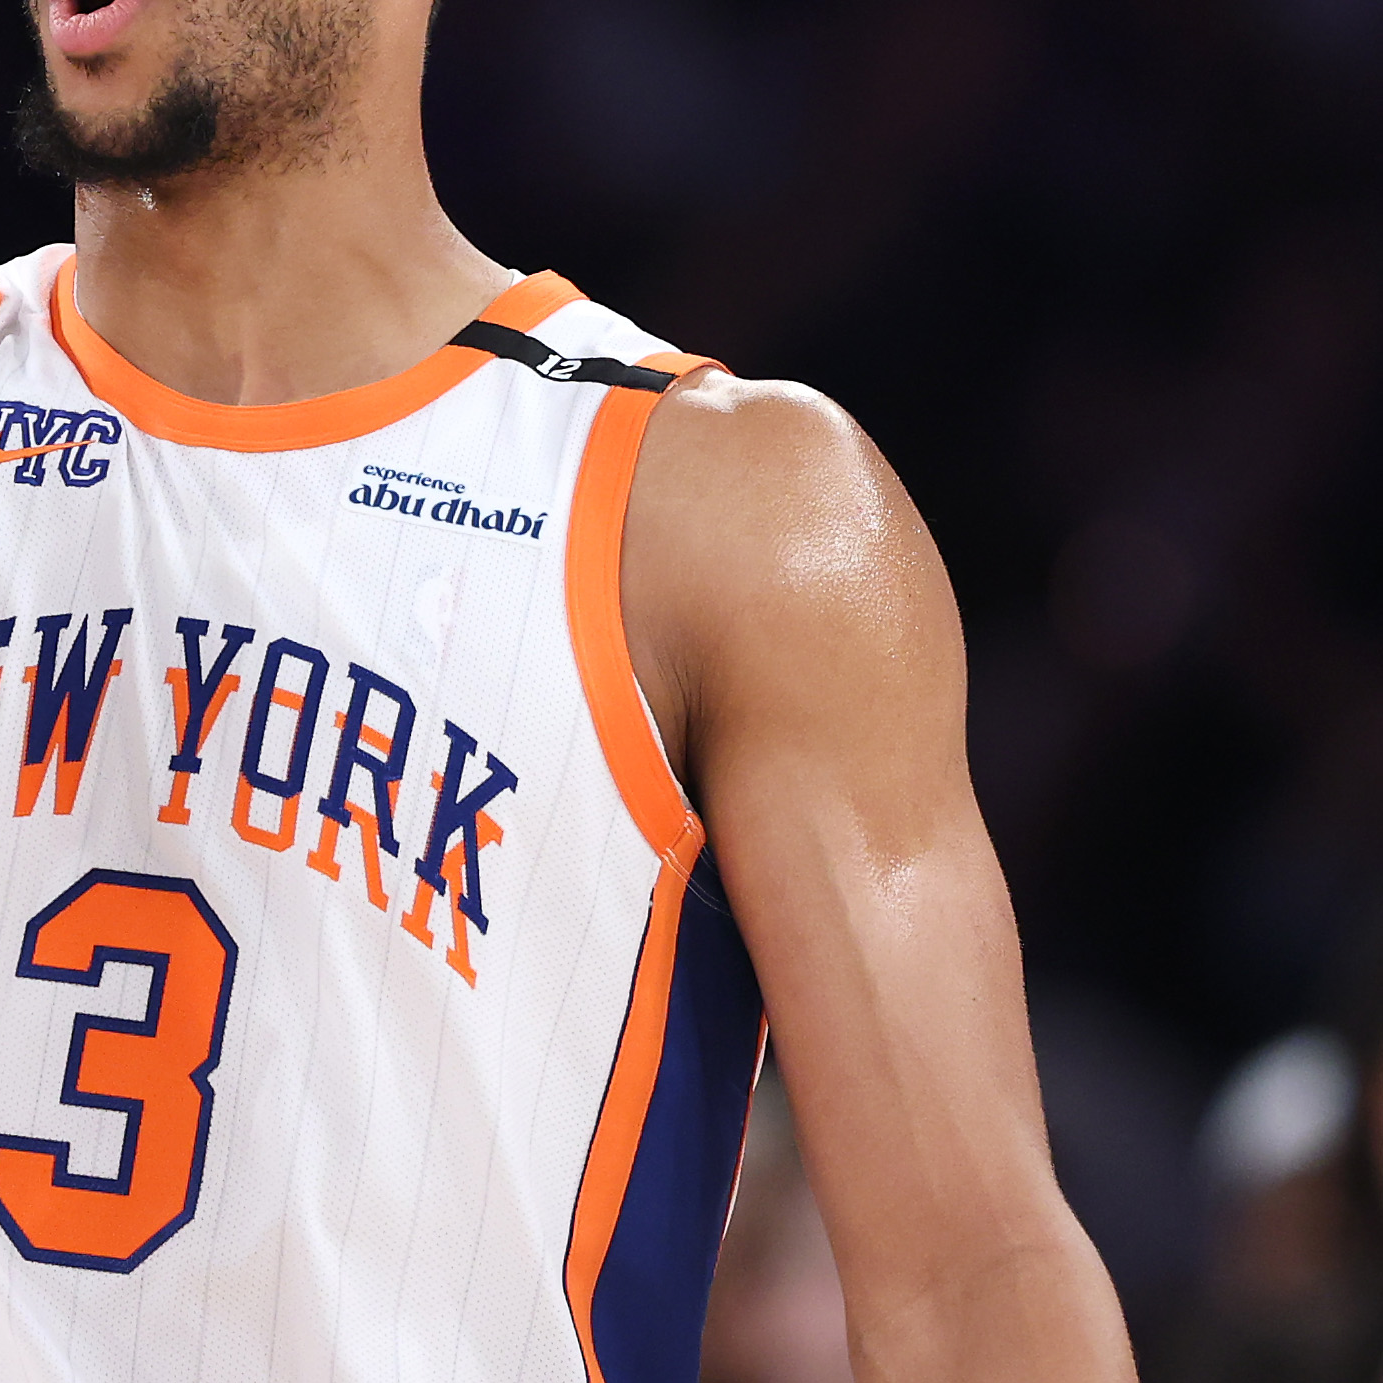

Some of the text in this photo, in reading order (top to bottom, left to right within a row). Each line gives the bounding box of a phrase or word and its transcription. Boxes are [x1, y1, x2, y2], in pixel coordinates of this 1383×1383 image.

[535, 353, 582, 380] 12
[362, 464, 466, 494] experience
[348, 483, 549, 540] abu dhabi
[168, 616, 518, 936] YORK
